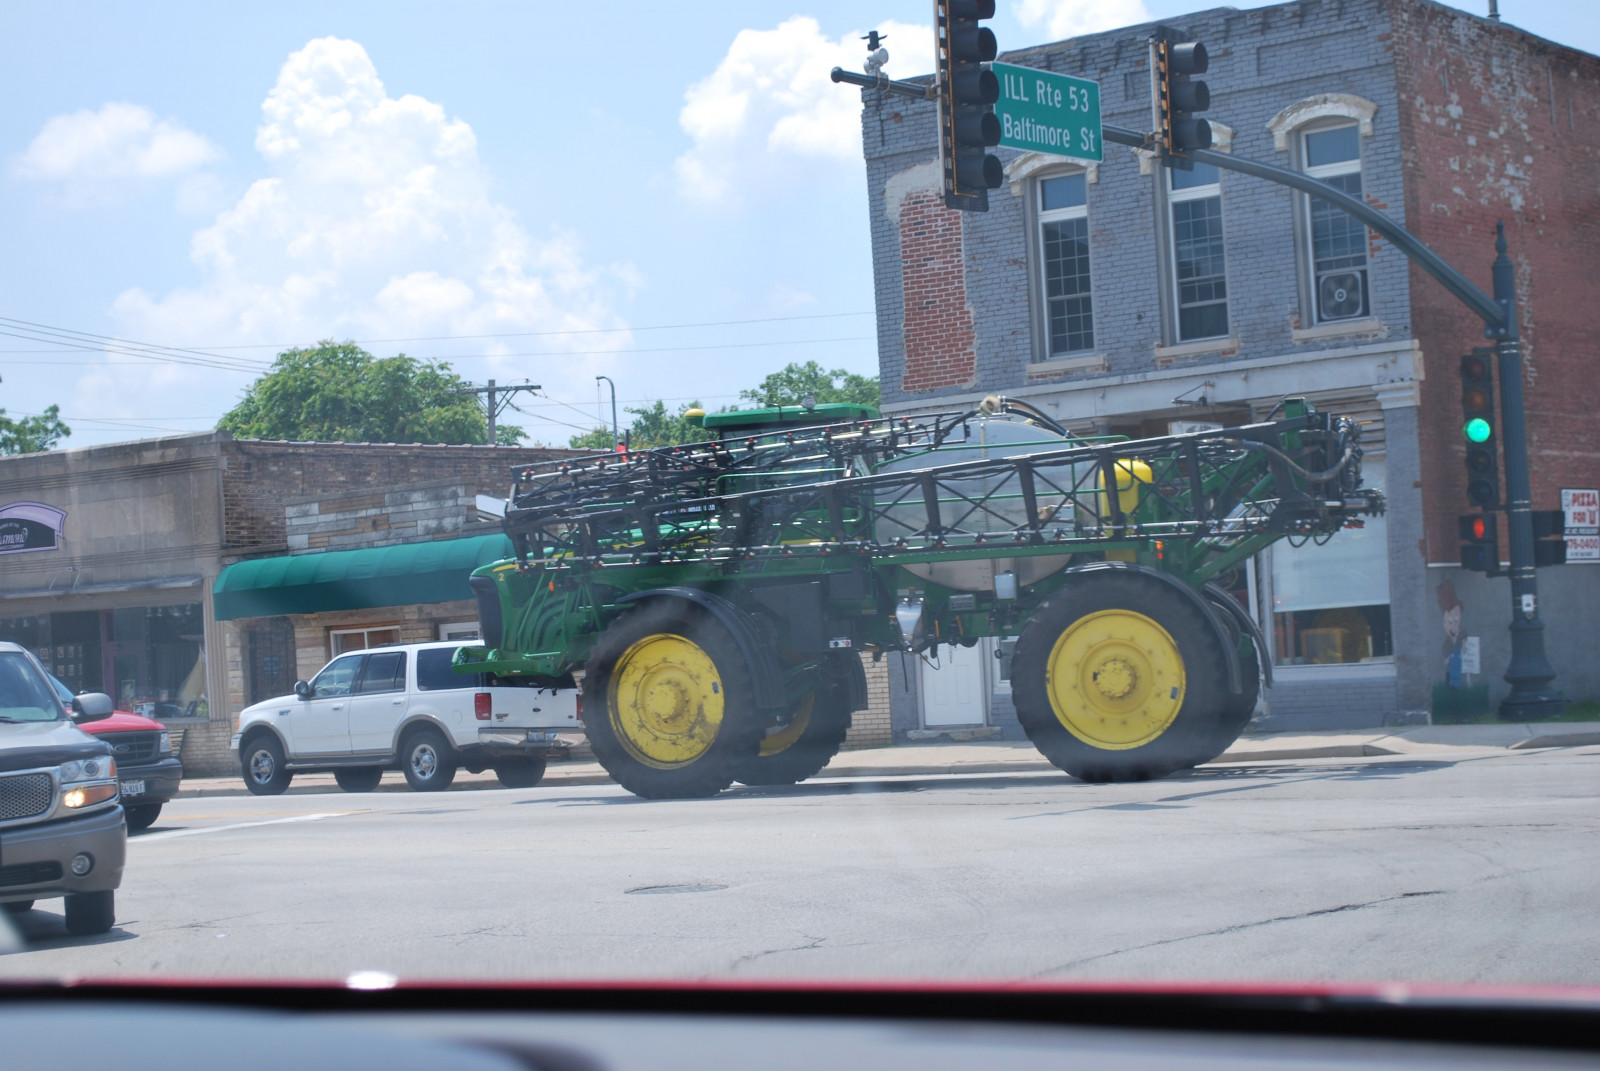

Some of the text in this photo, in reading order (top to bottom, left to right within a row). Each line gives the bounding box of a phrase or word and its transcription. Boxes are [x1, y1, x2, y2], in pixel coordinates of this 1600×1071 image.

[1004, 73, 1089, 112] ILL Rte 53
[1003, 113, 1096, 152] Baltimore St
[1572, 492, 1598, 507] PIZZA
[1573, 512, 1587, 524] FOR
[1566, 538, 1598, 549] 76-0400
